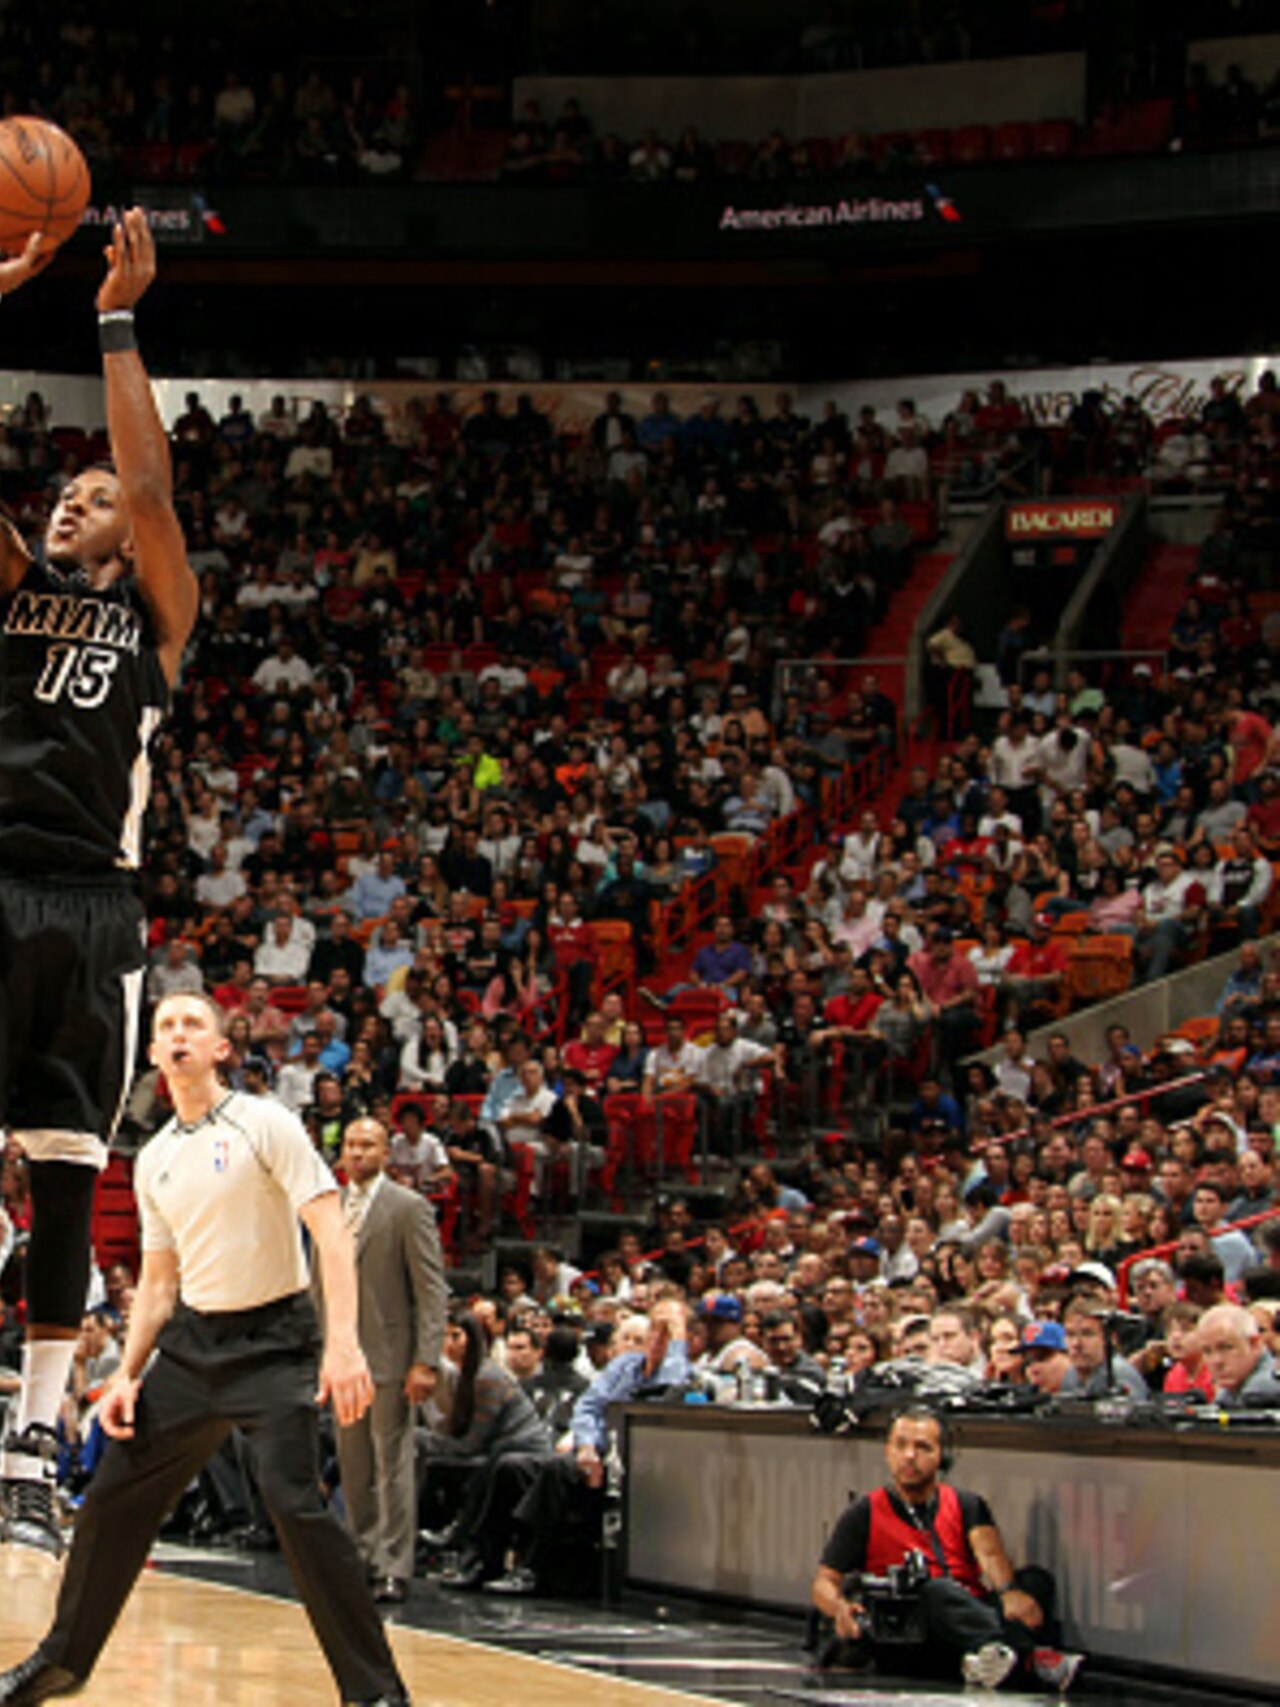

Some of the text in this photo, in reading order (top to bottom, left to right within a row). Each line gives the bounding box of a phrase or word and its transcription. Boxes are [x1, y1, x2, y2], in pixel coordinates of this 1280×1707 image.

[720, 197, 924, 229] American Airlines
[1010, 507, 1114, 532] BACARDI
[3, 590, 143, 656] MIAMI
[34, 641, 120, 710] 15
